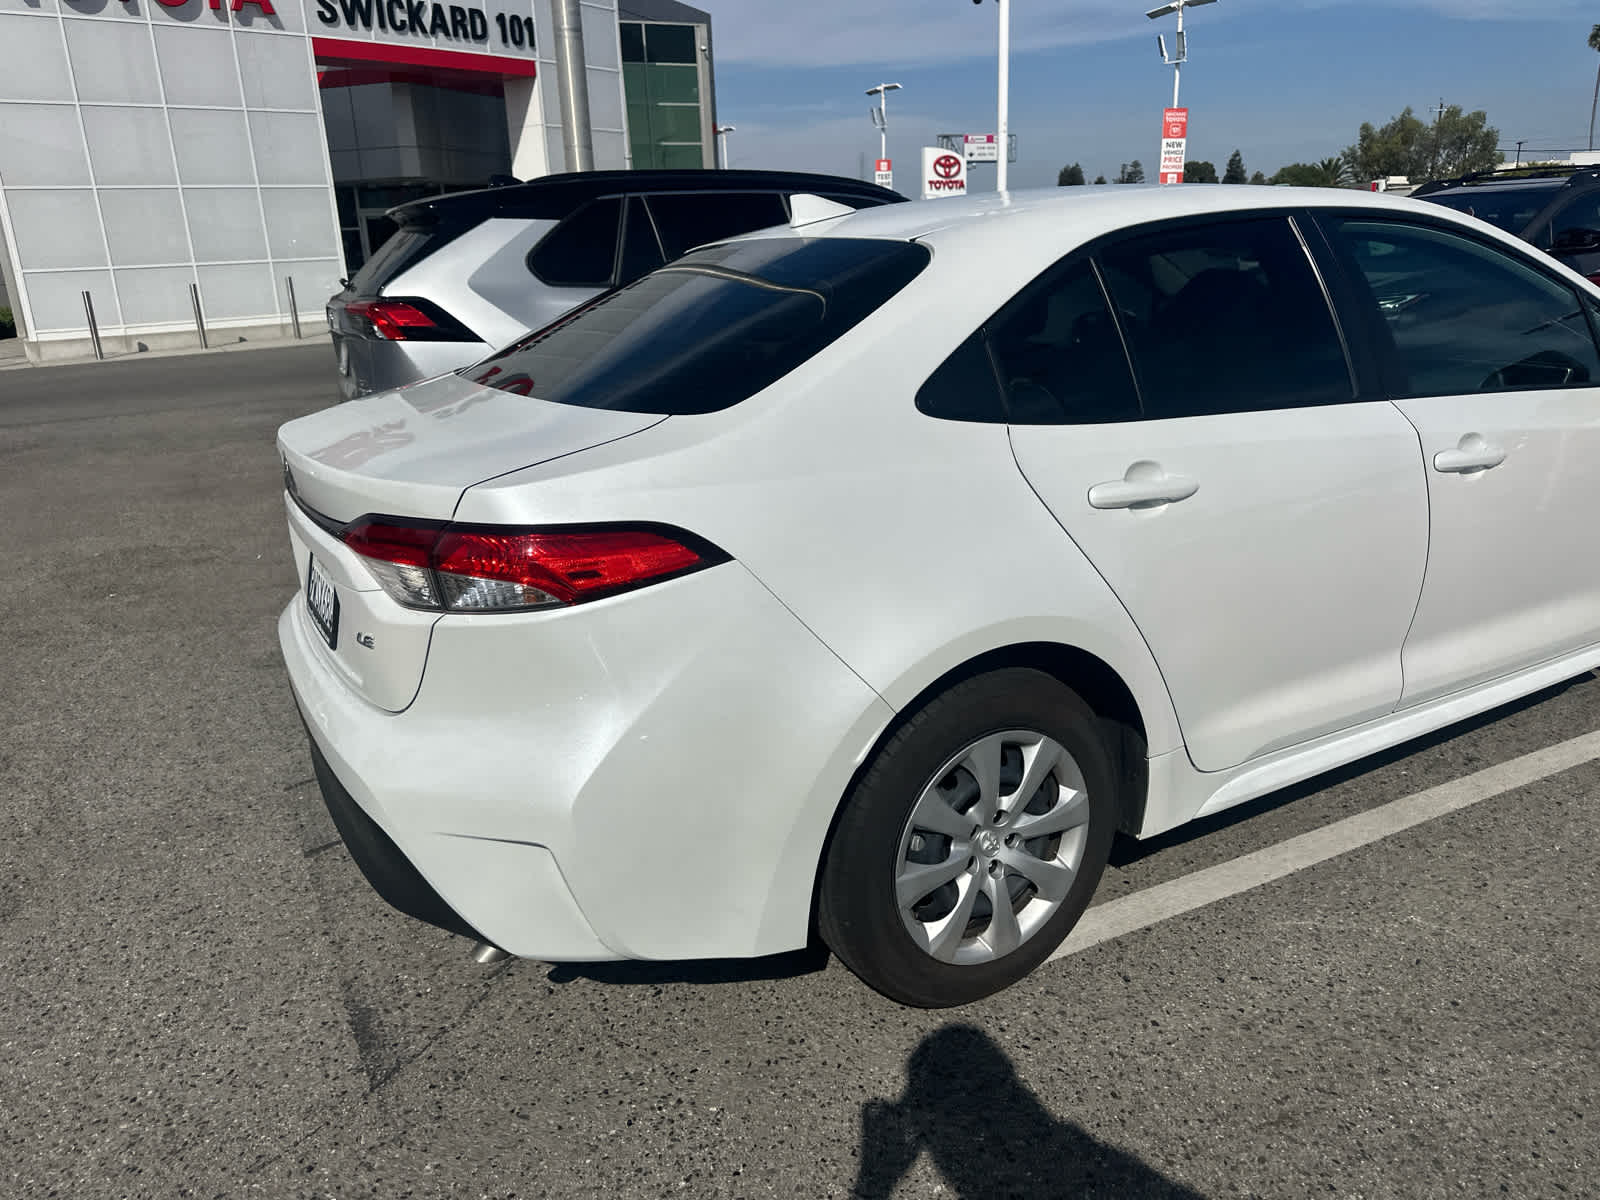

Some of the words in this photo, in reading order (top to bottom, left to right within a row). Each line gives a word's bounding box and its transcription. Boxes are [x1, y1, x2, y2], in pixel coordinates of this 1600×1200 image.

[317, 0, 488, 41] SWICKARD
[496, 13, 536, 48] 101
[928, 180, 965, 191] TOYOTA
[357, 632, 375, 650] LE
